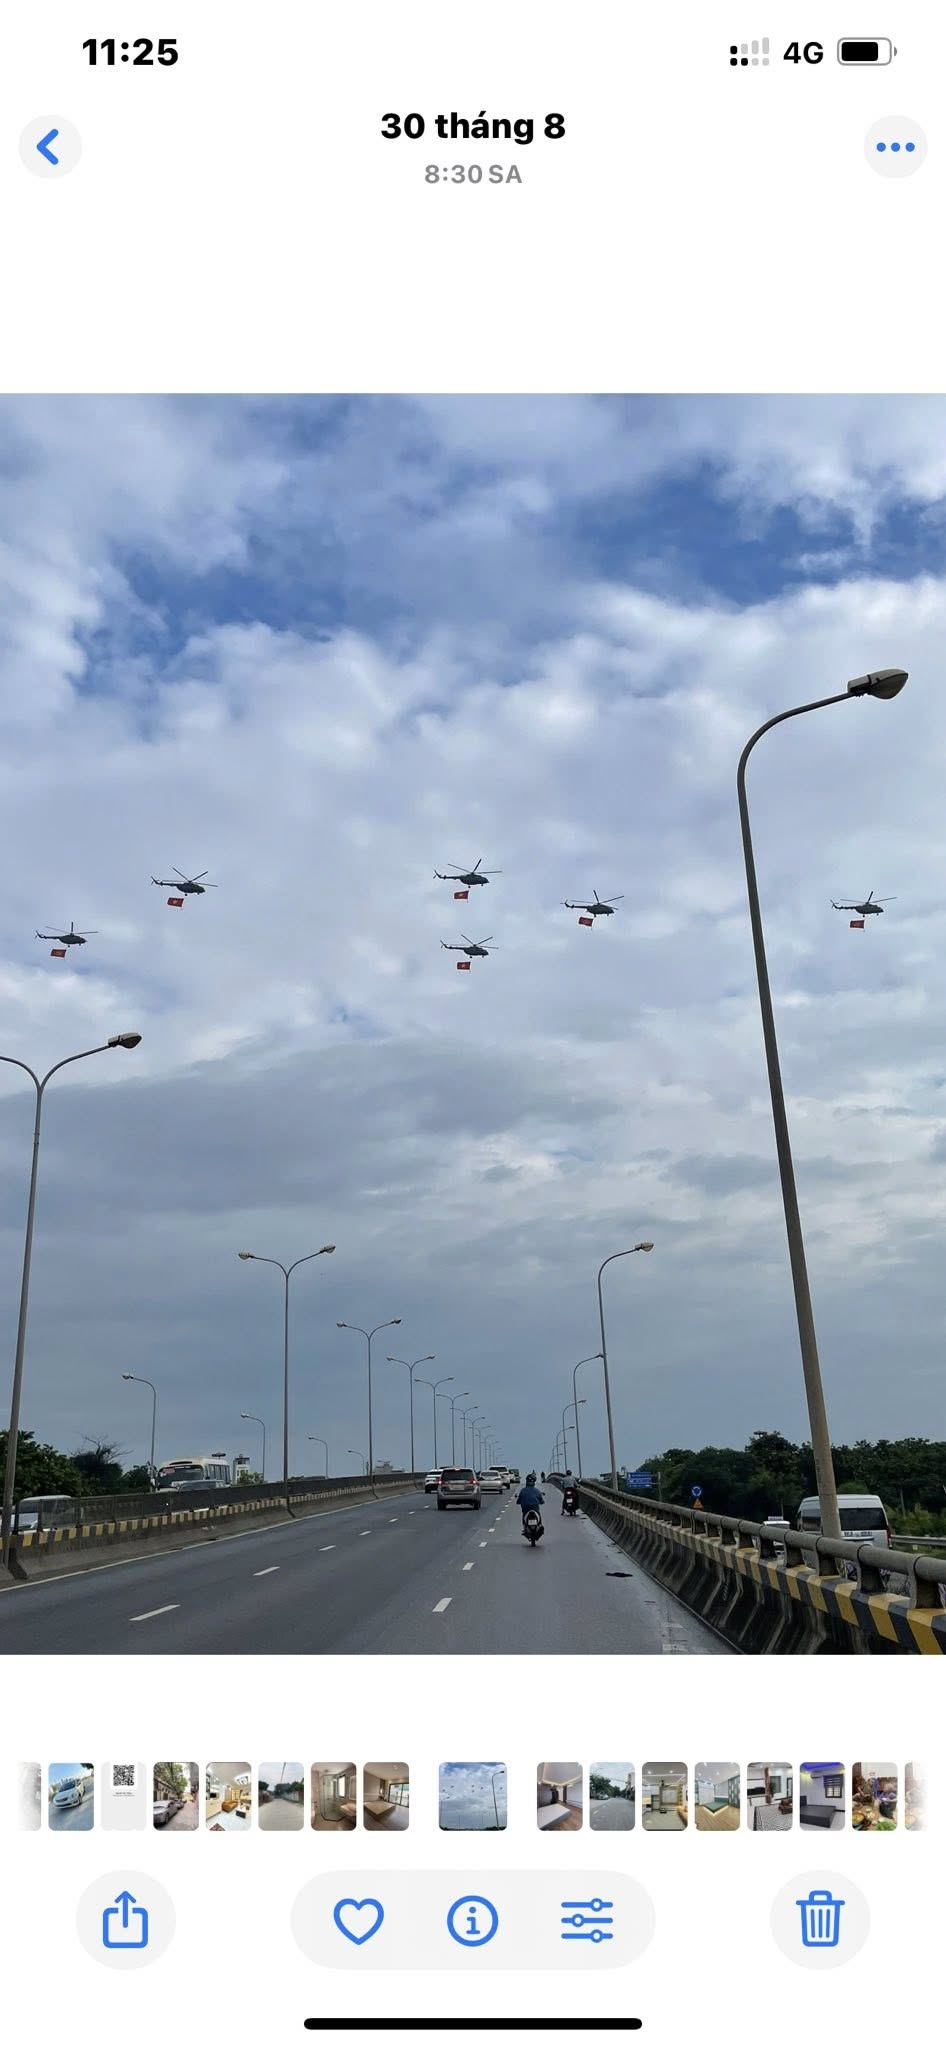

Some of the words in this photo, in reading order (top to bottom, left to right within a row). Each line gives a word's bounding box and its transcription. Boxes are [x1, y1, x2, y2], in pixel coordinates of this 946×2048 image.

[82, 37, 179, 67] 11:25
[783, 41, 824, 65] 4G
[380, 112, 426, 140] 30
[434, 110, 534, 146] tháng
[543, 112, 566, 140] 8
[424, 164, 483, 184] 8:30
[488, 164, 523, 184] SA
